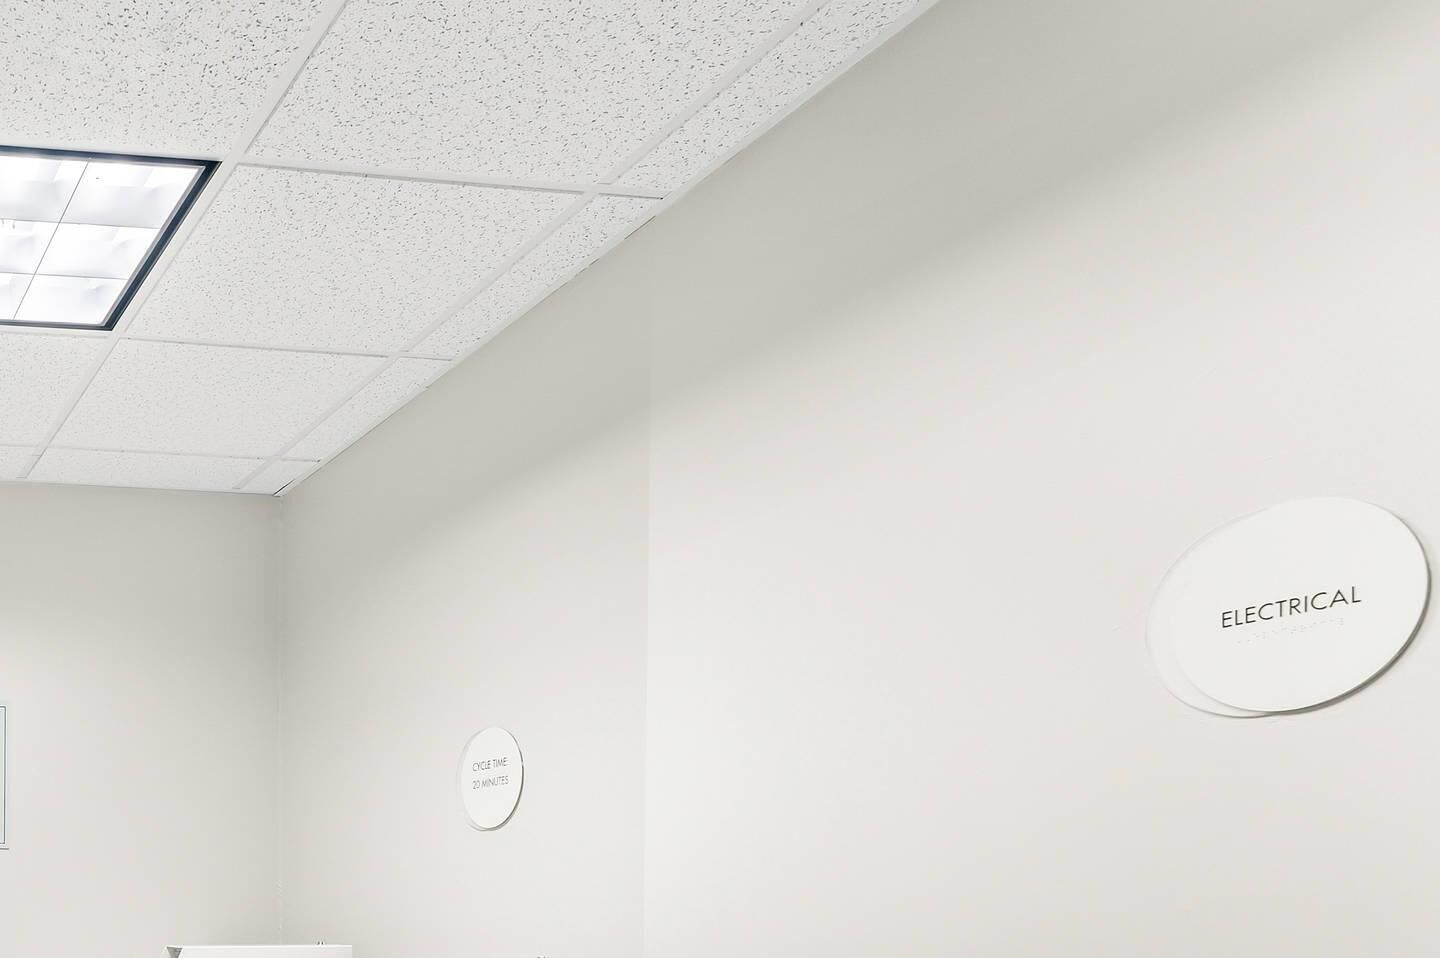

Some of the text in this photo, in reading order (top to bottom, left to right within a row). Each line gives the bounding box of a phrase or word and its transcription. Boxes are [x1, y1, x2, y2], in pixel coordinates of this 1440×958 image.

[1221, 586, 1362, 629] ELECTRICAL
[472, 756, 509, 772] CYCLE TIME
[481, 775, 509, 788] MINUTES
